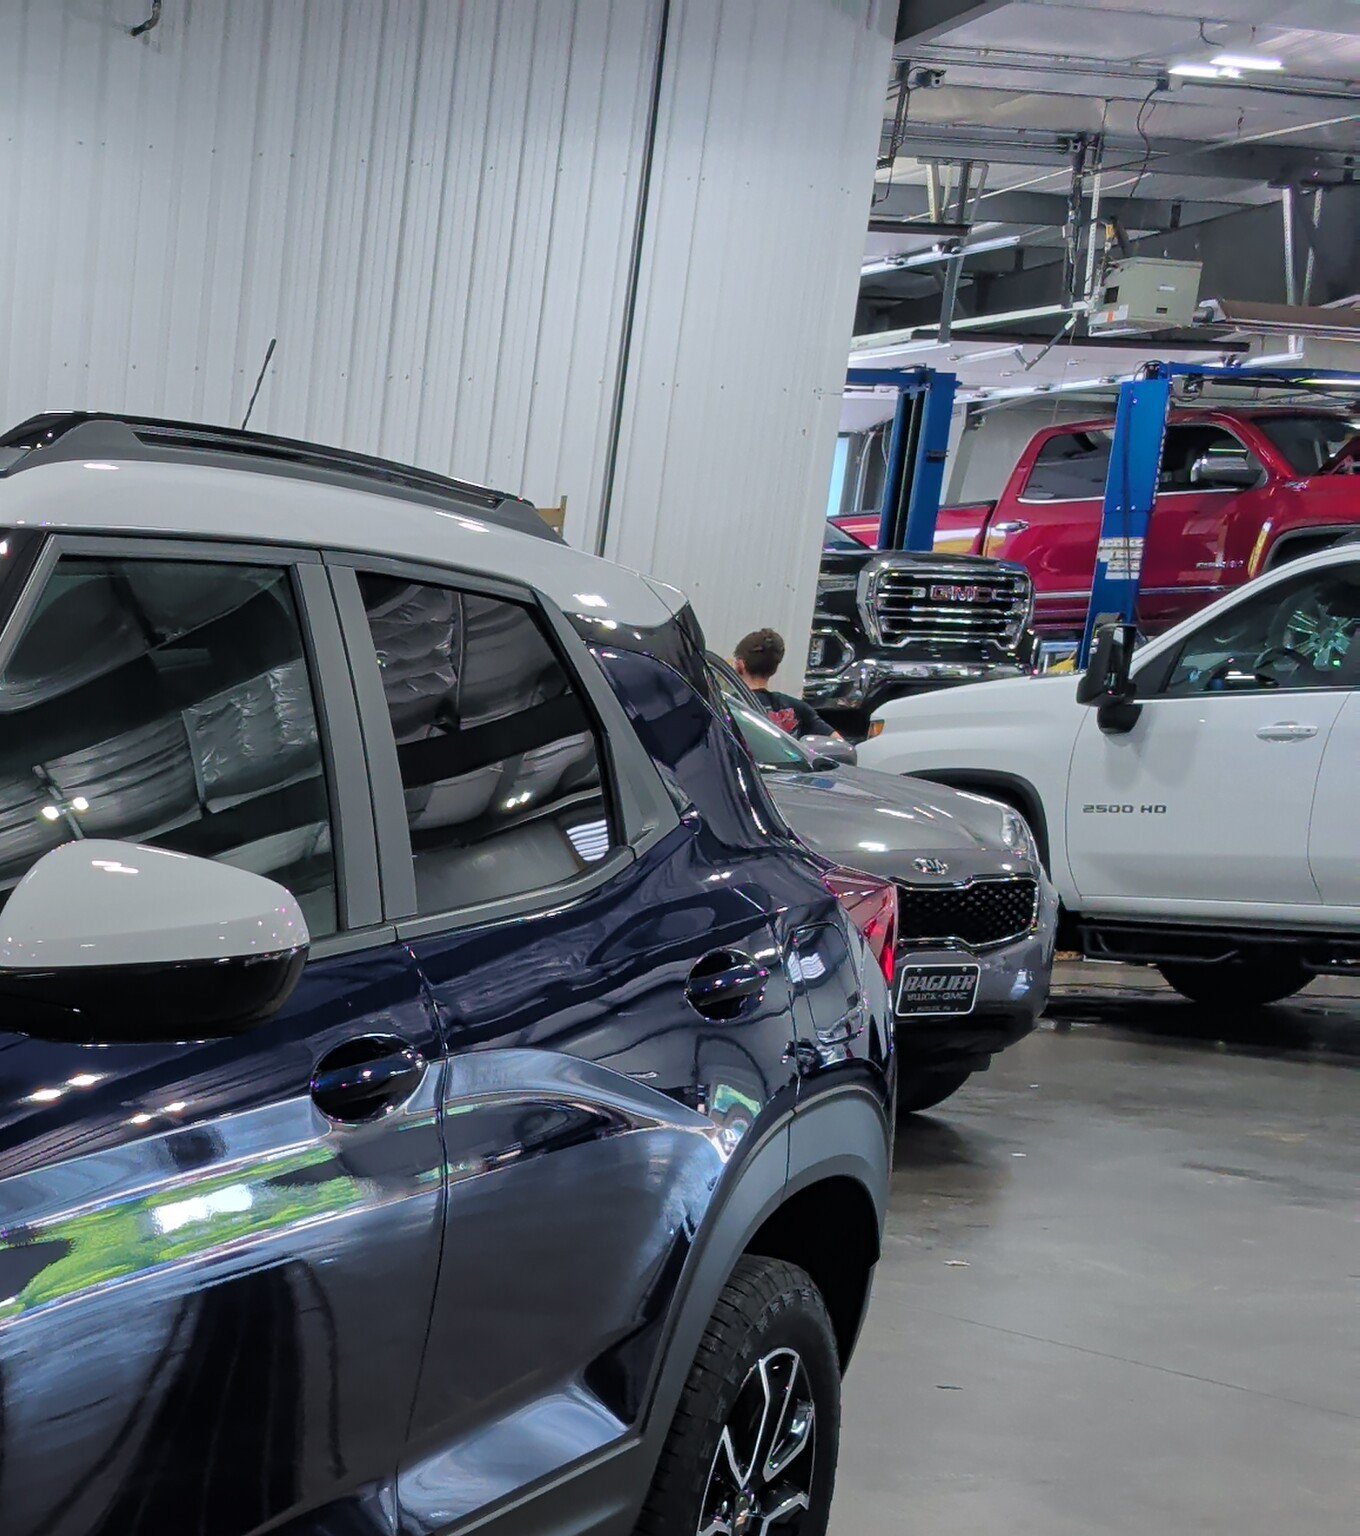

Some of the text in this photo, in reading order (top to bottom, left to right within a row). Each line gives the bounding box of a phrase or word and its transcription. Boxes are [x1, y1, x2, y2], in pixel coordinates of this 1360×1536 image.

[1082, 804, 1167, 814] 2500 HD
[903, 974, 977, 991] BAGLIER
